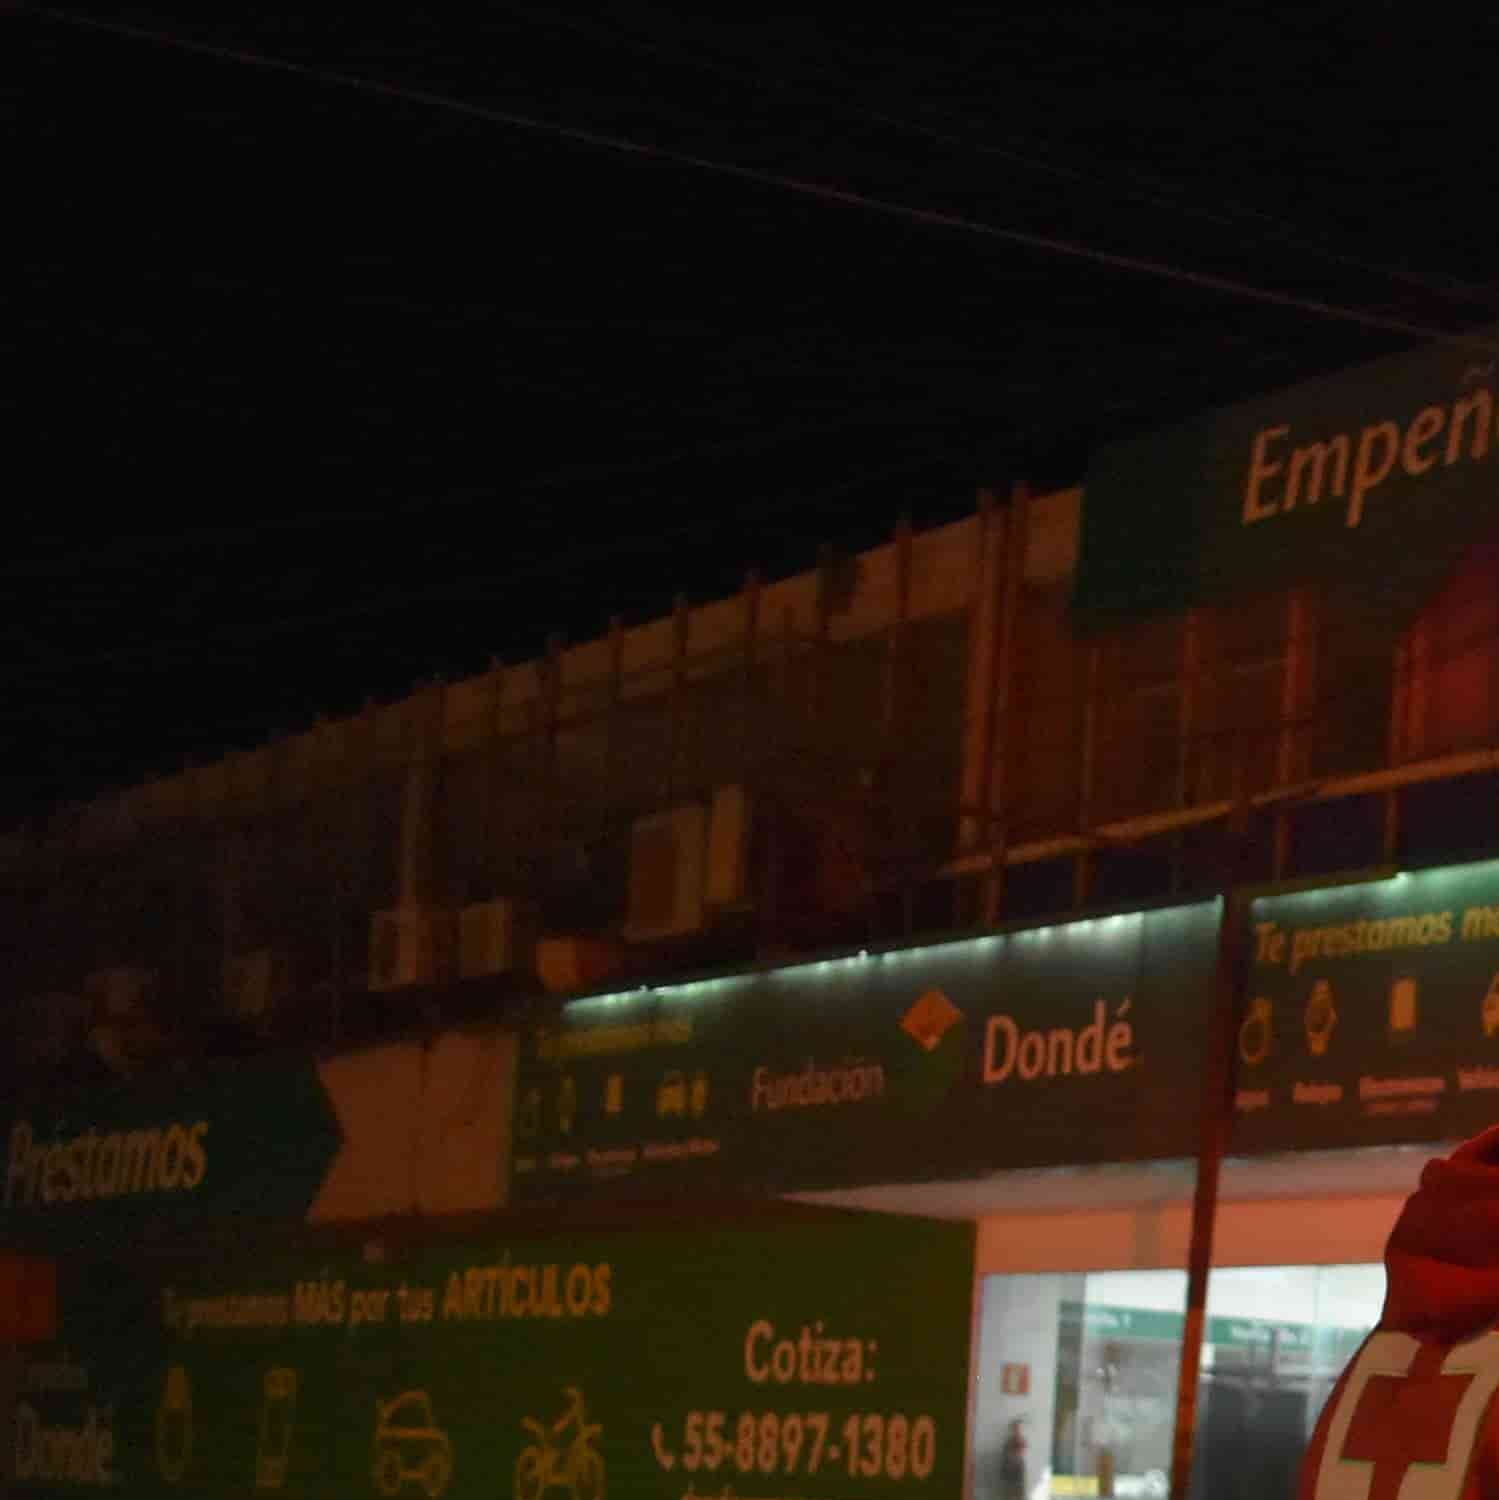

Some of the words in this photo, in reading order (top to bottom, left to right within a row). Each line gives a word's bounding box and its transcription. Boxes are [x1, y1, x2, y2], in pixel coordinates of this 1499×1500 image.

[1255, 920, 1287, 963] Te
[1290, 908, 1454, 974] prestamos
[983, 997, 1136, 1085] Dondé
[752, 1058, 884, 1111] Fundación
[443, 1250, 614, 1318] ARTÍCULOS
[744, 1319, 879, 1384] Cotiza:
[682, 1408, 936, 1480] 55-8897-1380
